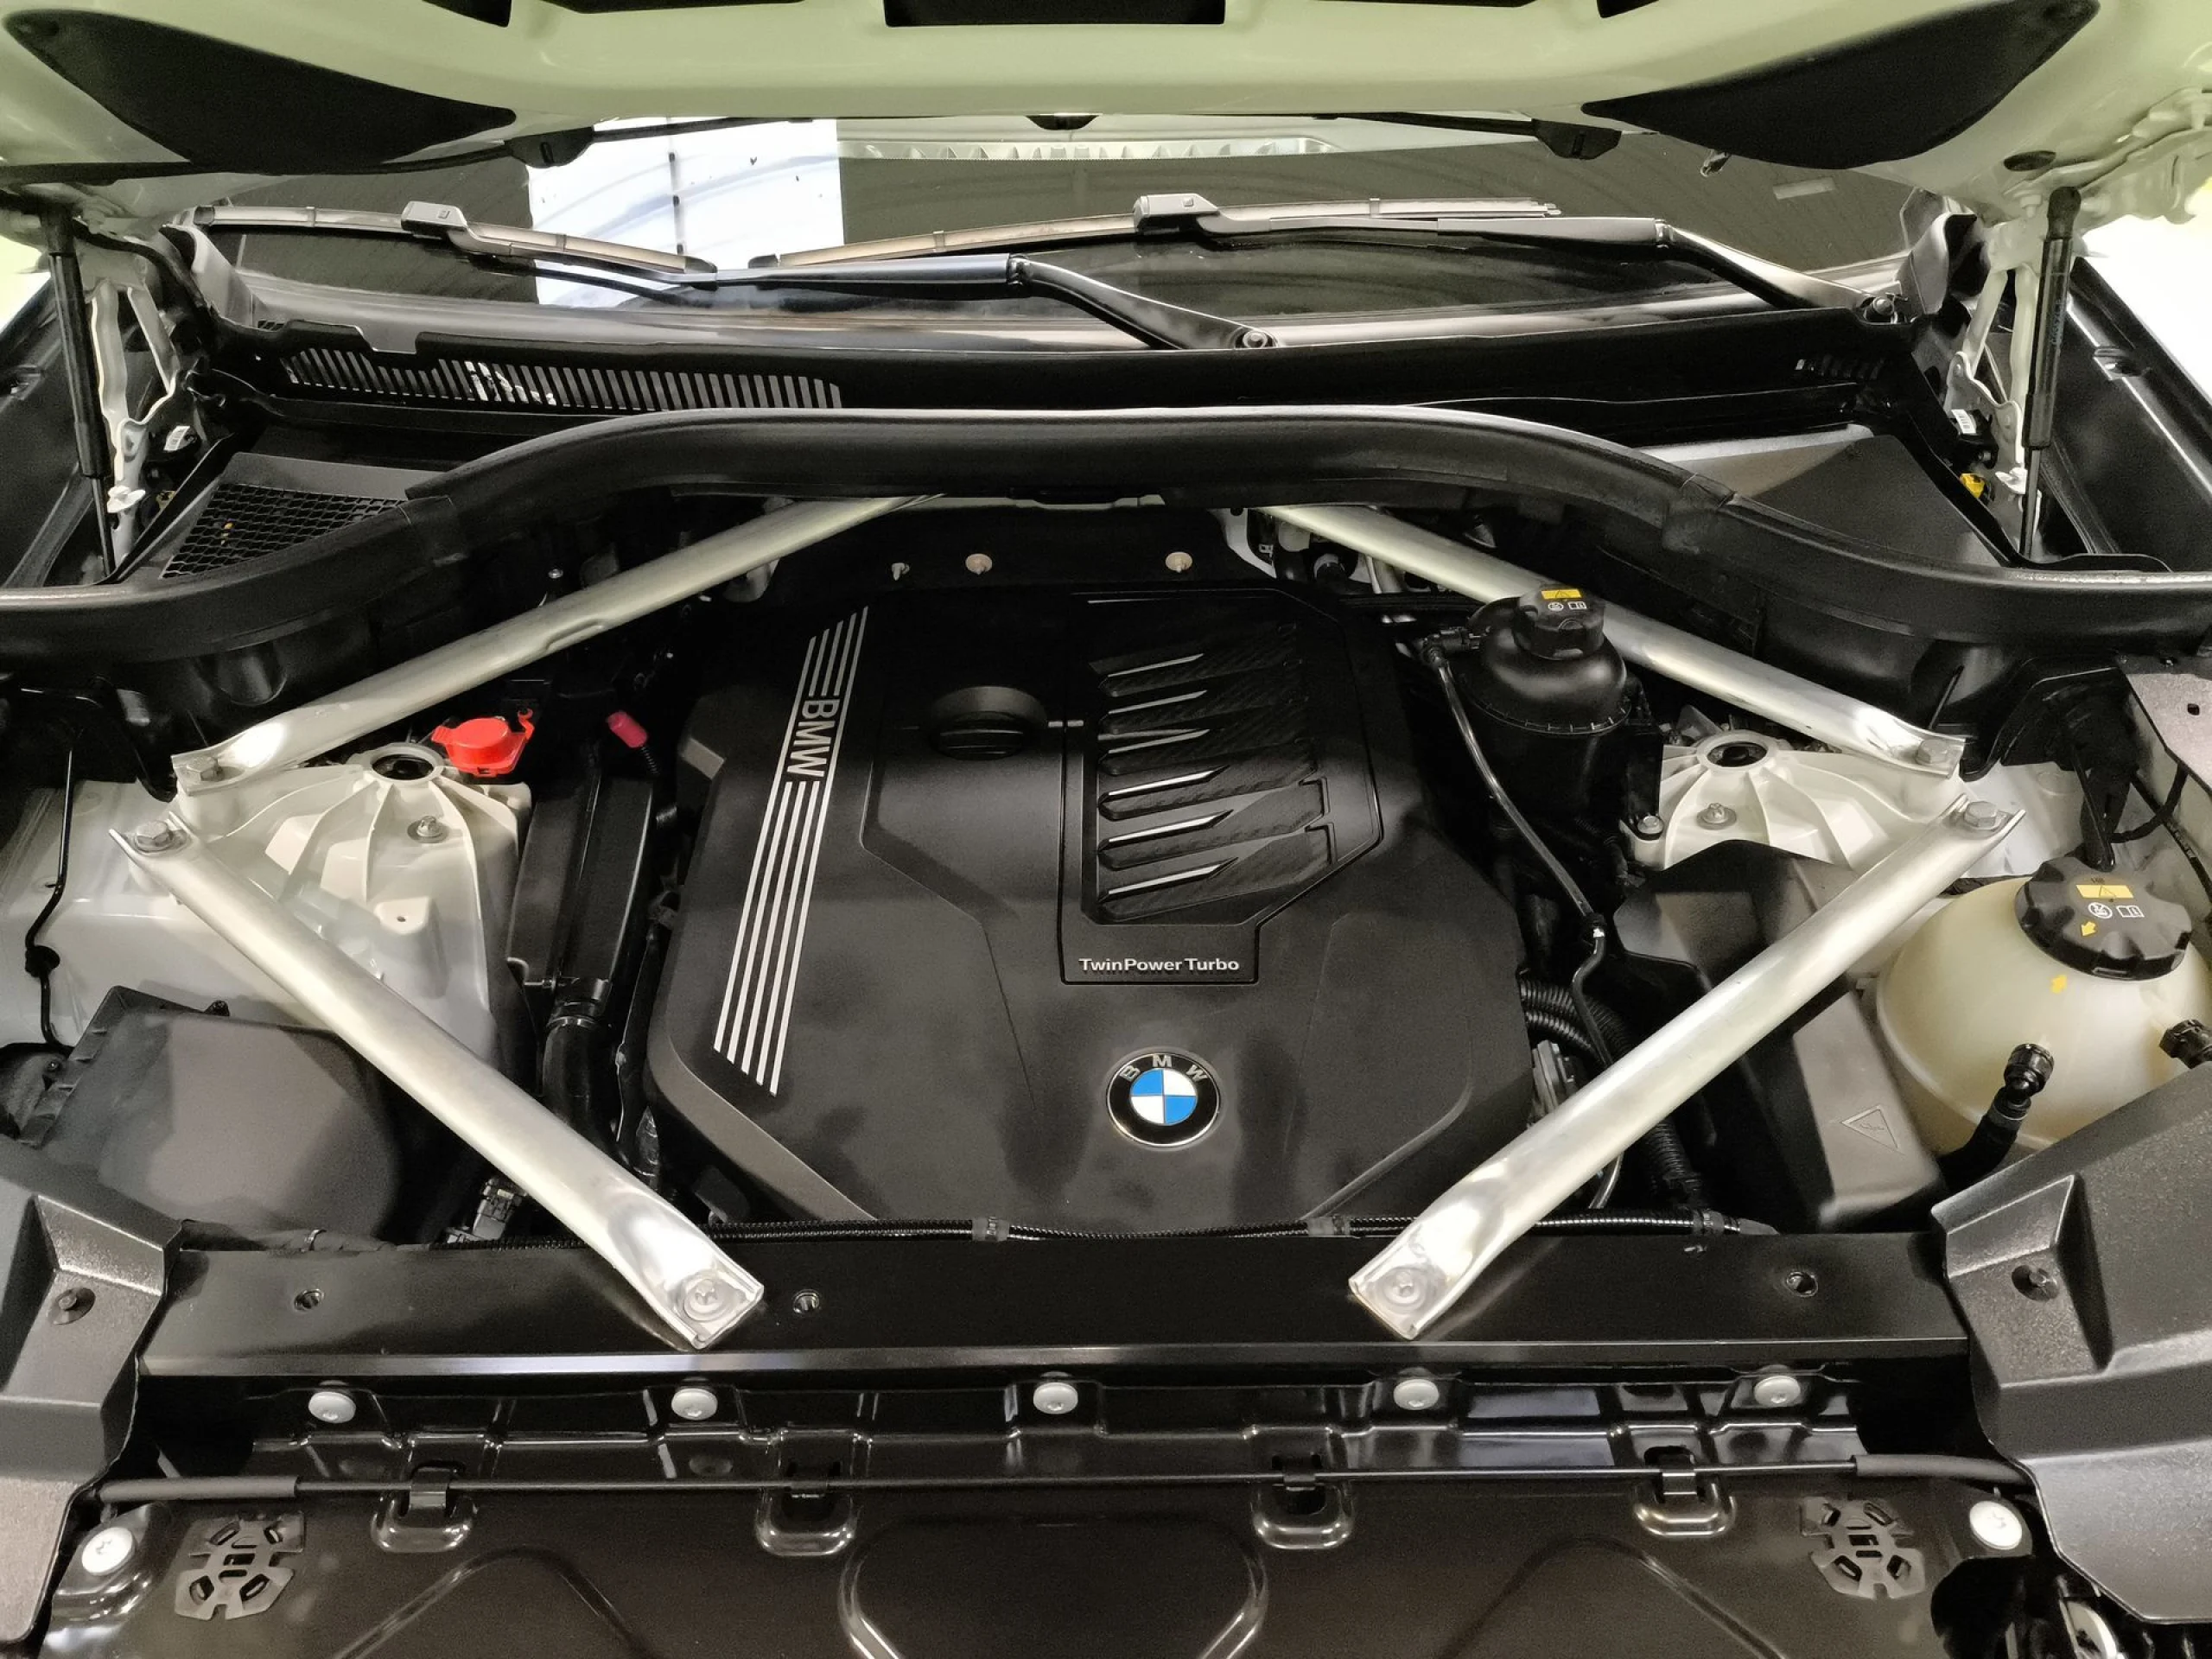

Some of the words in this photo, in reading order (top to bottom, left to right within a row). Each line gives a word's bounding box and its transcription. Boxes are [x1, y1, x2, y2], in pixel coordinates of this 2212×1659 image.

[786, 698, 841, 778] BMW
[1078, 957, 1183, 971] TwinPower
[1185, 957, 1240, 971] Turbo
[1120, 1054, 1208, 1082] BMW
